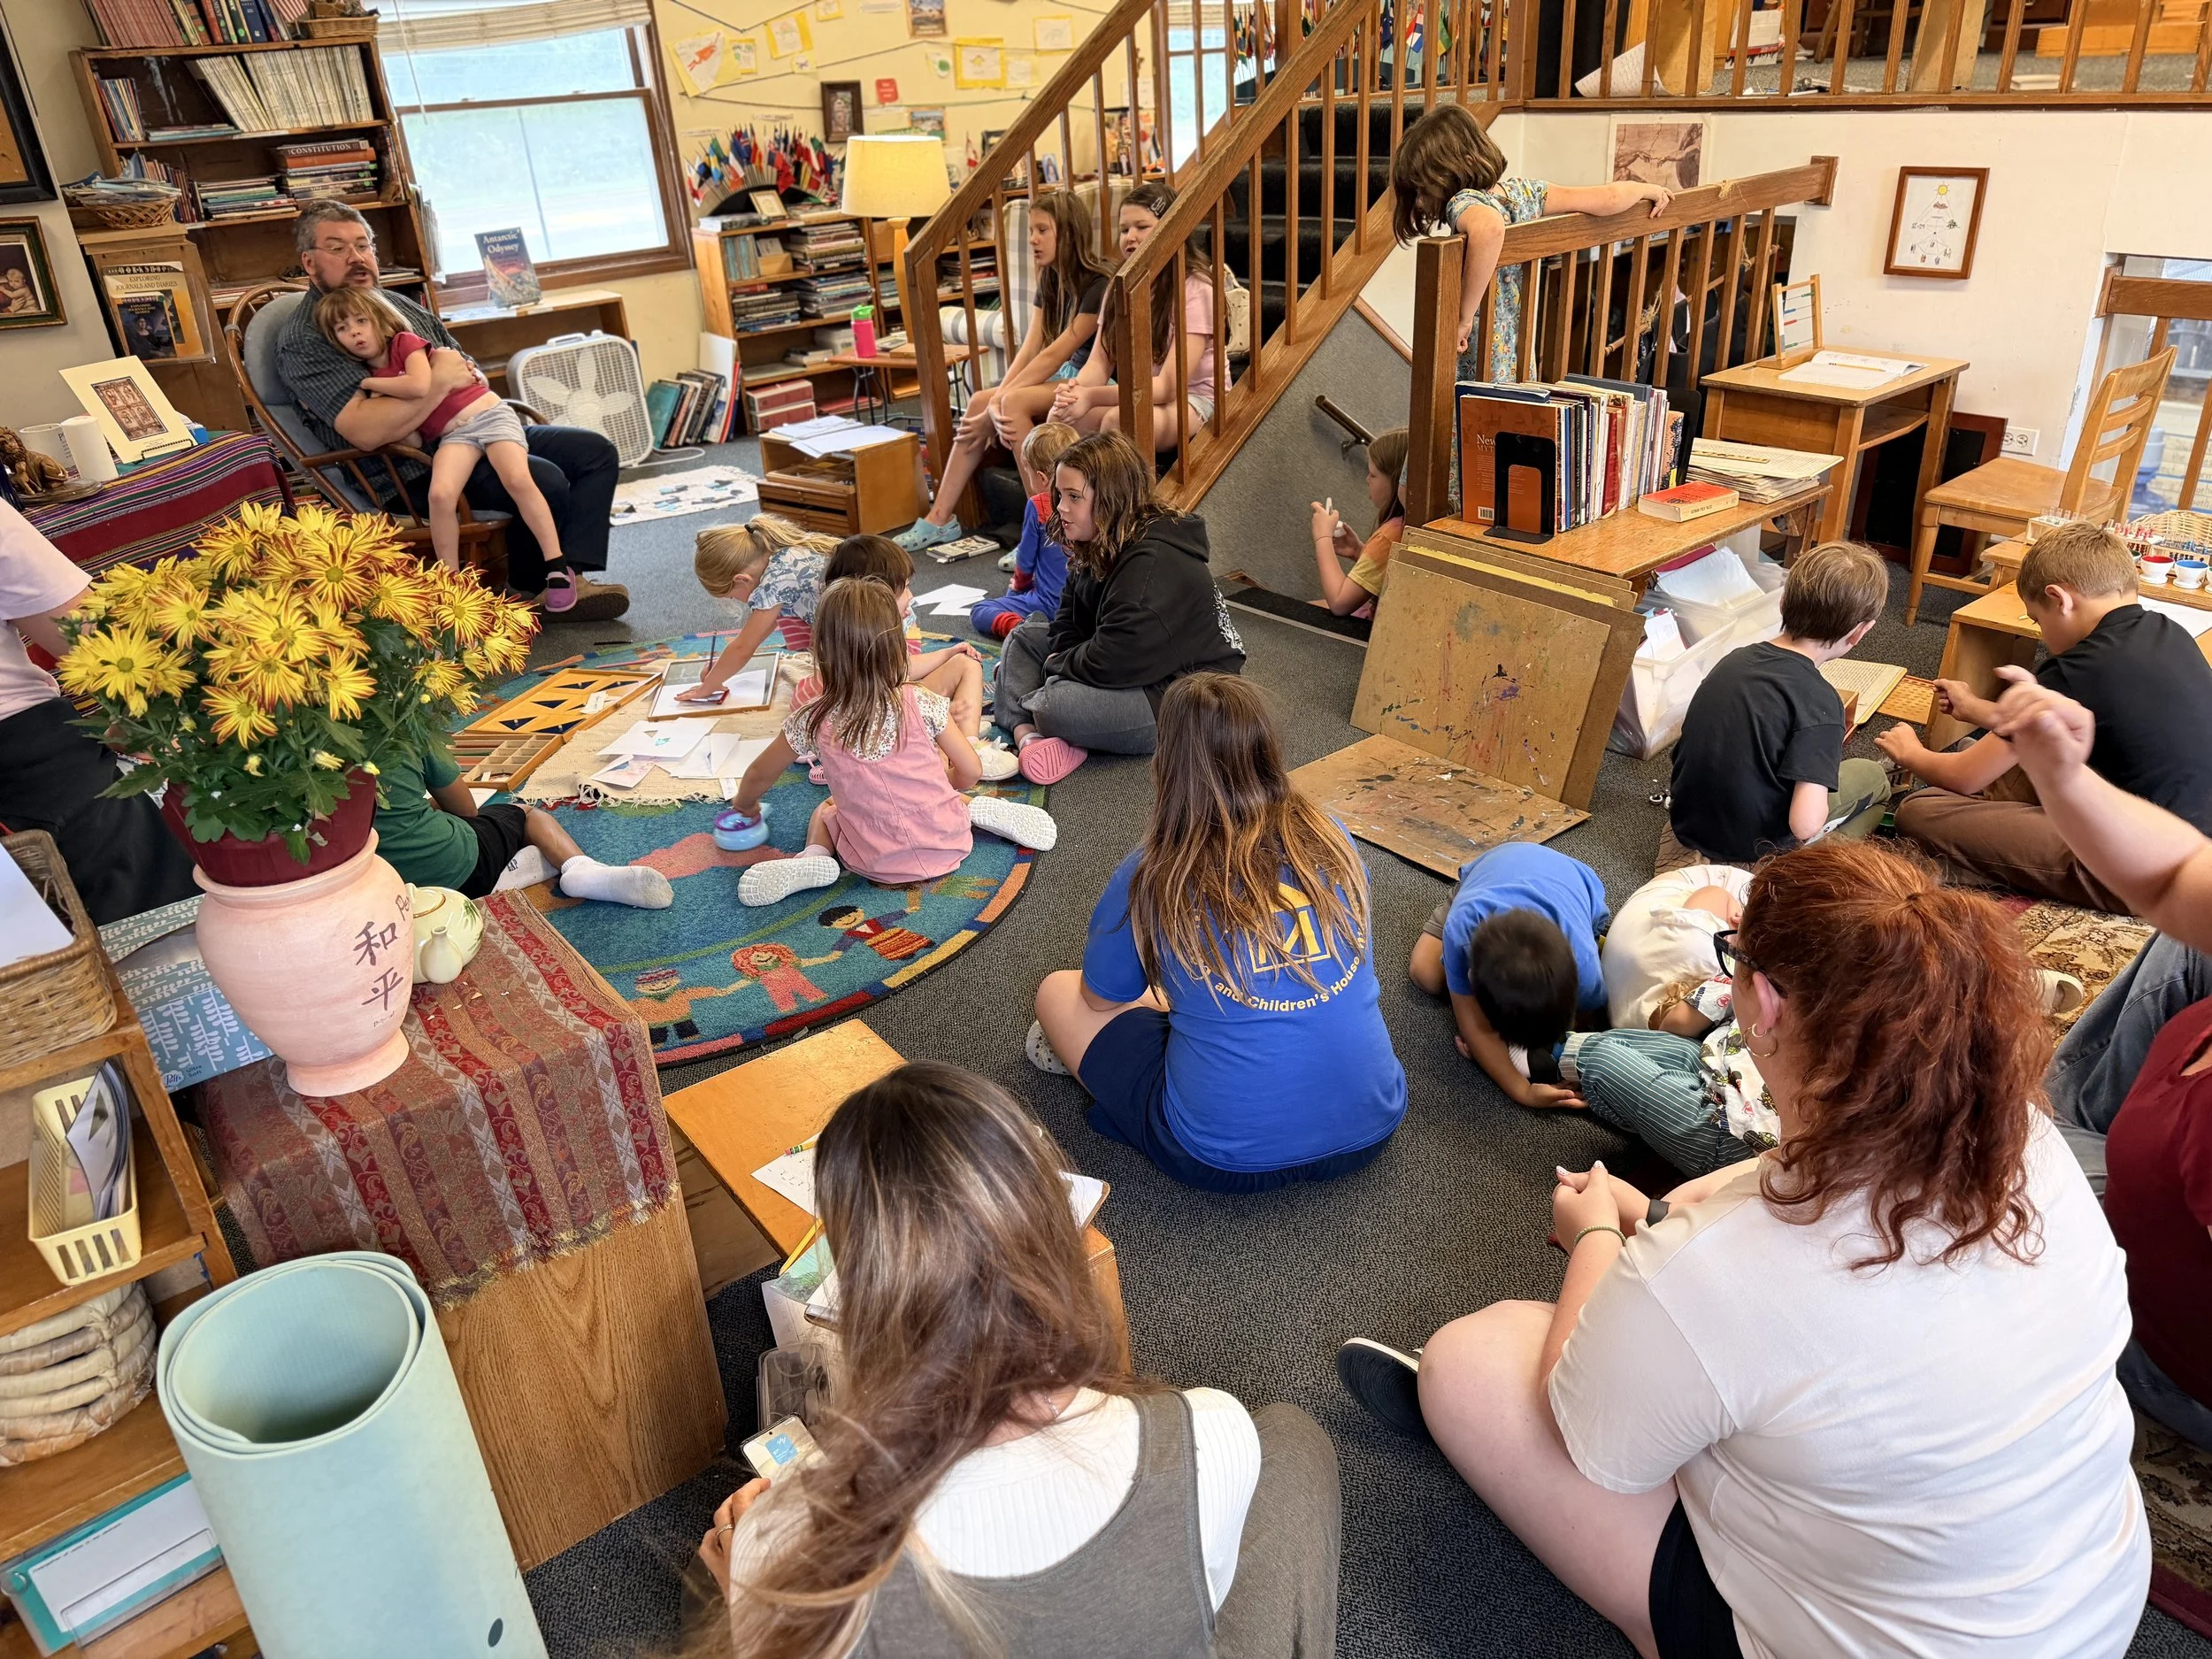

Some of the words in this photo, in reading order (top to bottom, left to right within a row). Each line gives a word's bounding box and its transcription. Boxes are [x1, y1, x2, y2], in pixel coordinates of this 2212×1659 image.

[290, 143, 351, 155] CONSTITUTION
[483, 232, 518, 244] Antarctic
[487, 243, 519, 254] Odyssey
[353, 921, 403, 1011] 和平
[1248, 991, 1330, 1012] Children's
[1330, 956, 1360, 996] House
[165, 1073, 181, 1085] Puffs
